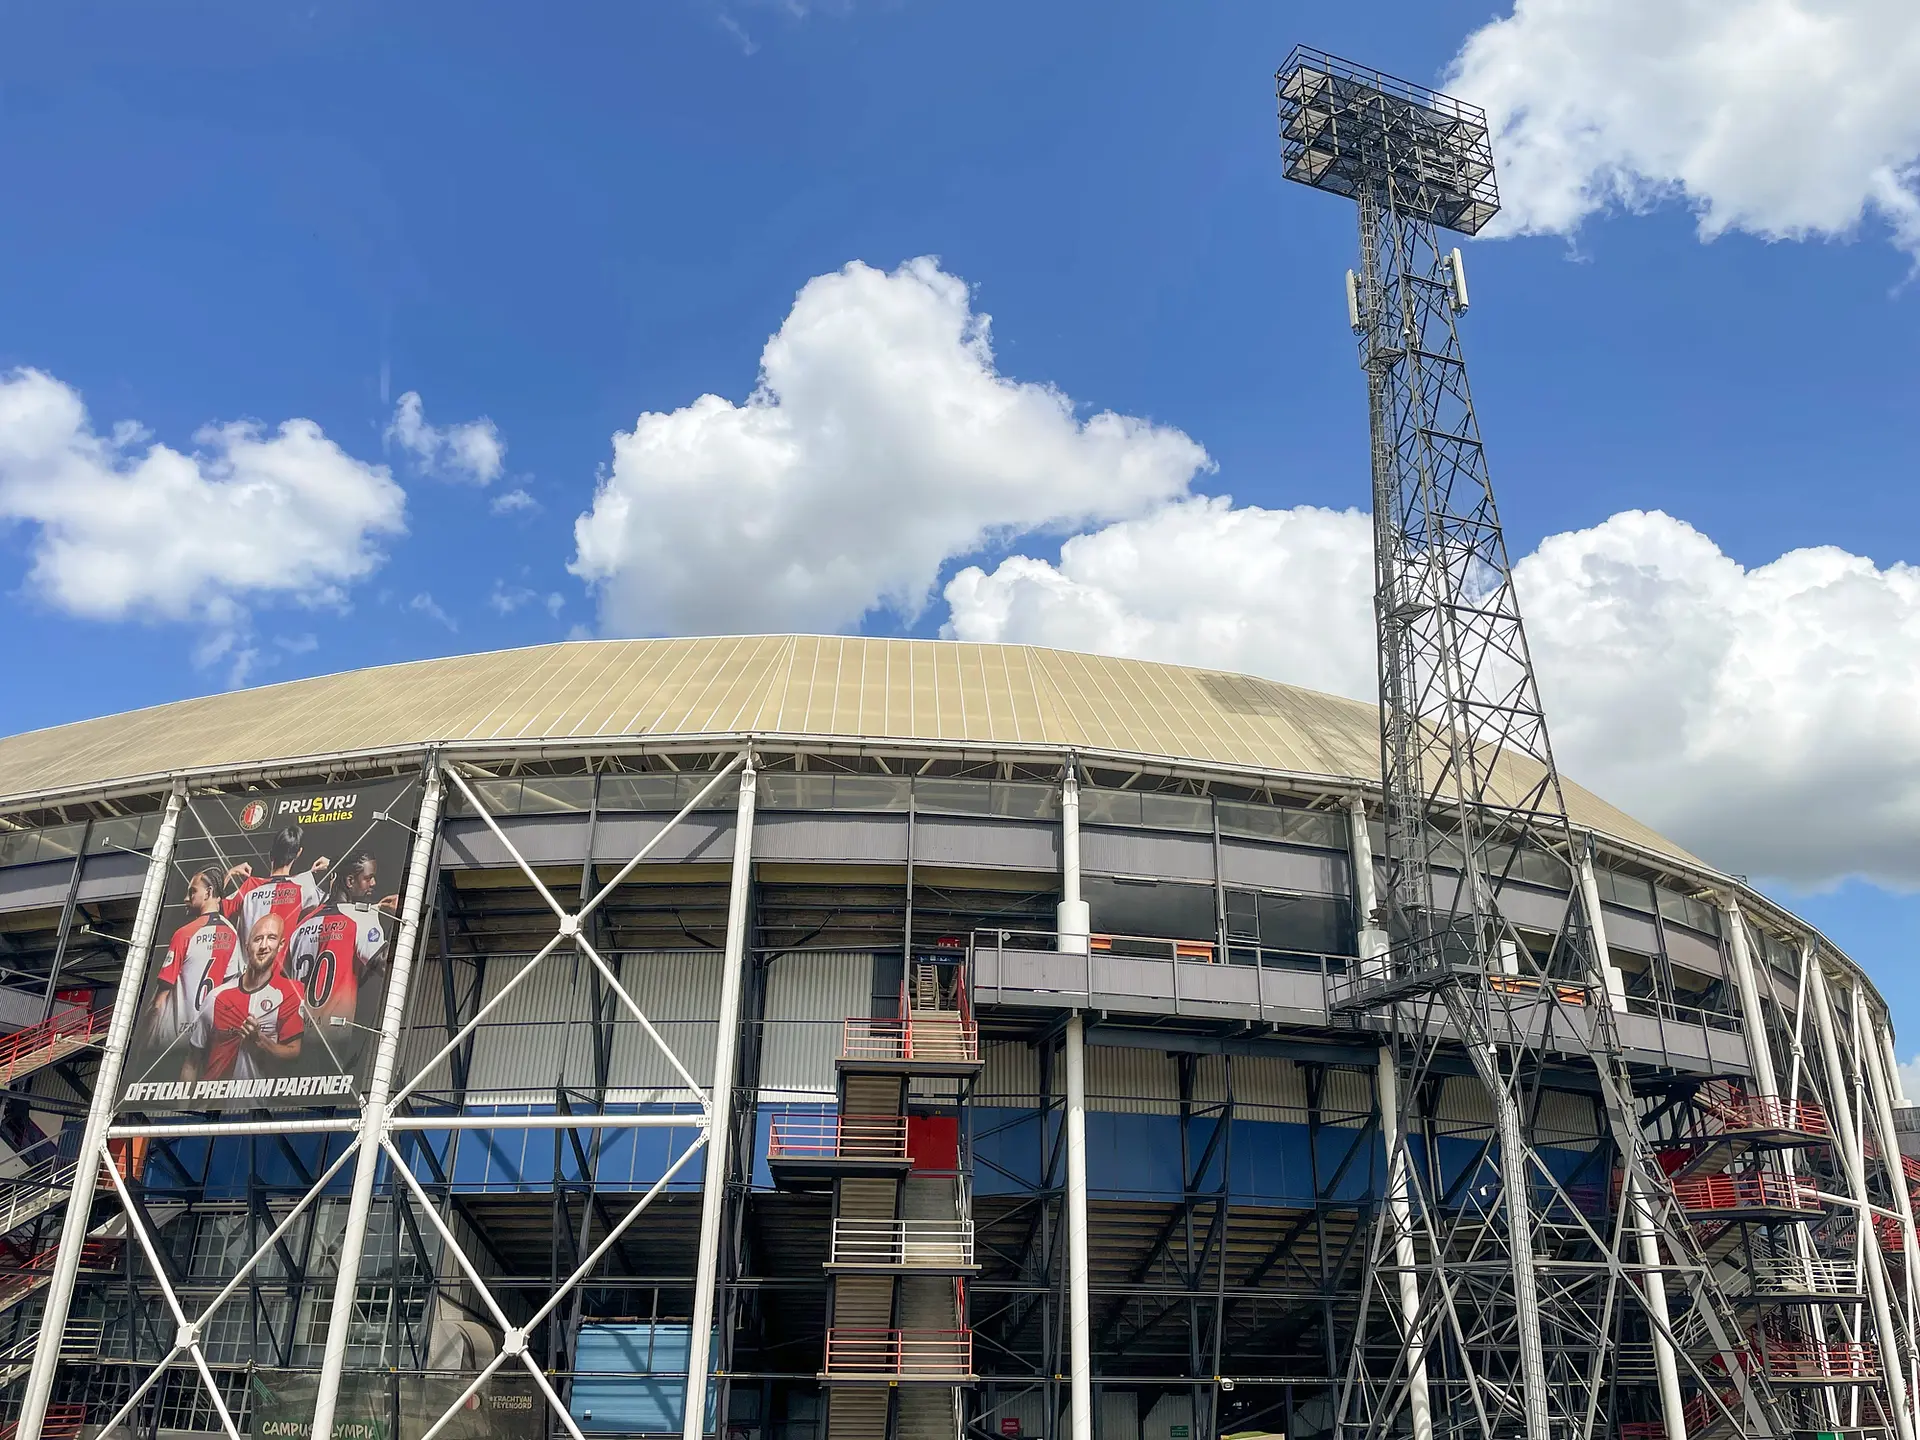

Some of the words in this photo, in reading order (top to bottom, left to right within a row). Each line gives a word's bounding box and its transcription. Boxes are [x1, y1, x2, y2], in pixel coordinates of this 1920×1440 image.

[298, 810, 354, 824] vakanties
[194, 956, 216, 1012] 6
[124, 1081, 192, 1101] OFFICIAL
[192, 1078, 276, 1099] PREMIUM
[274, 1074, 354, 1097] PARTNER
[331, 1424, 376, 1440] LYMPIA
